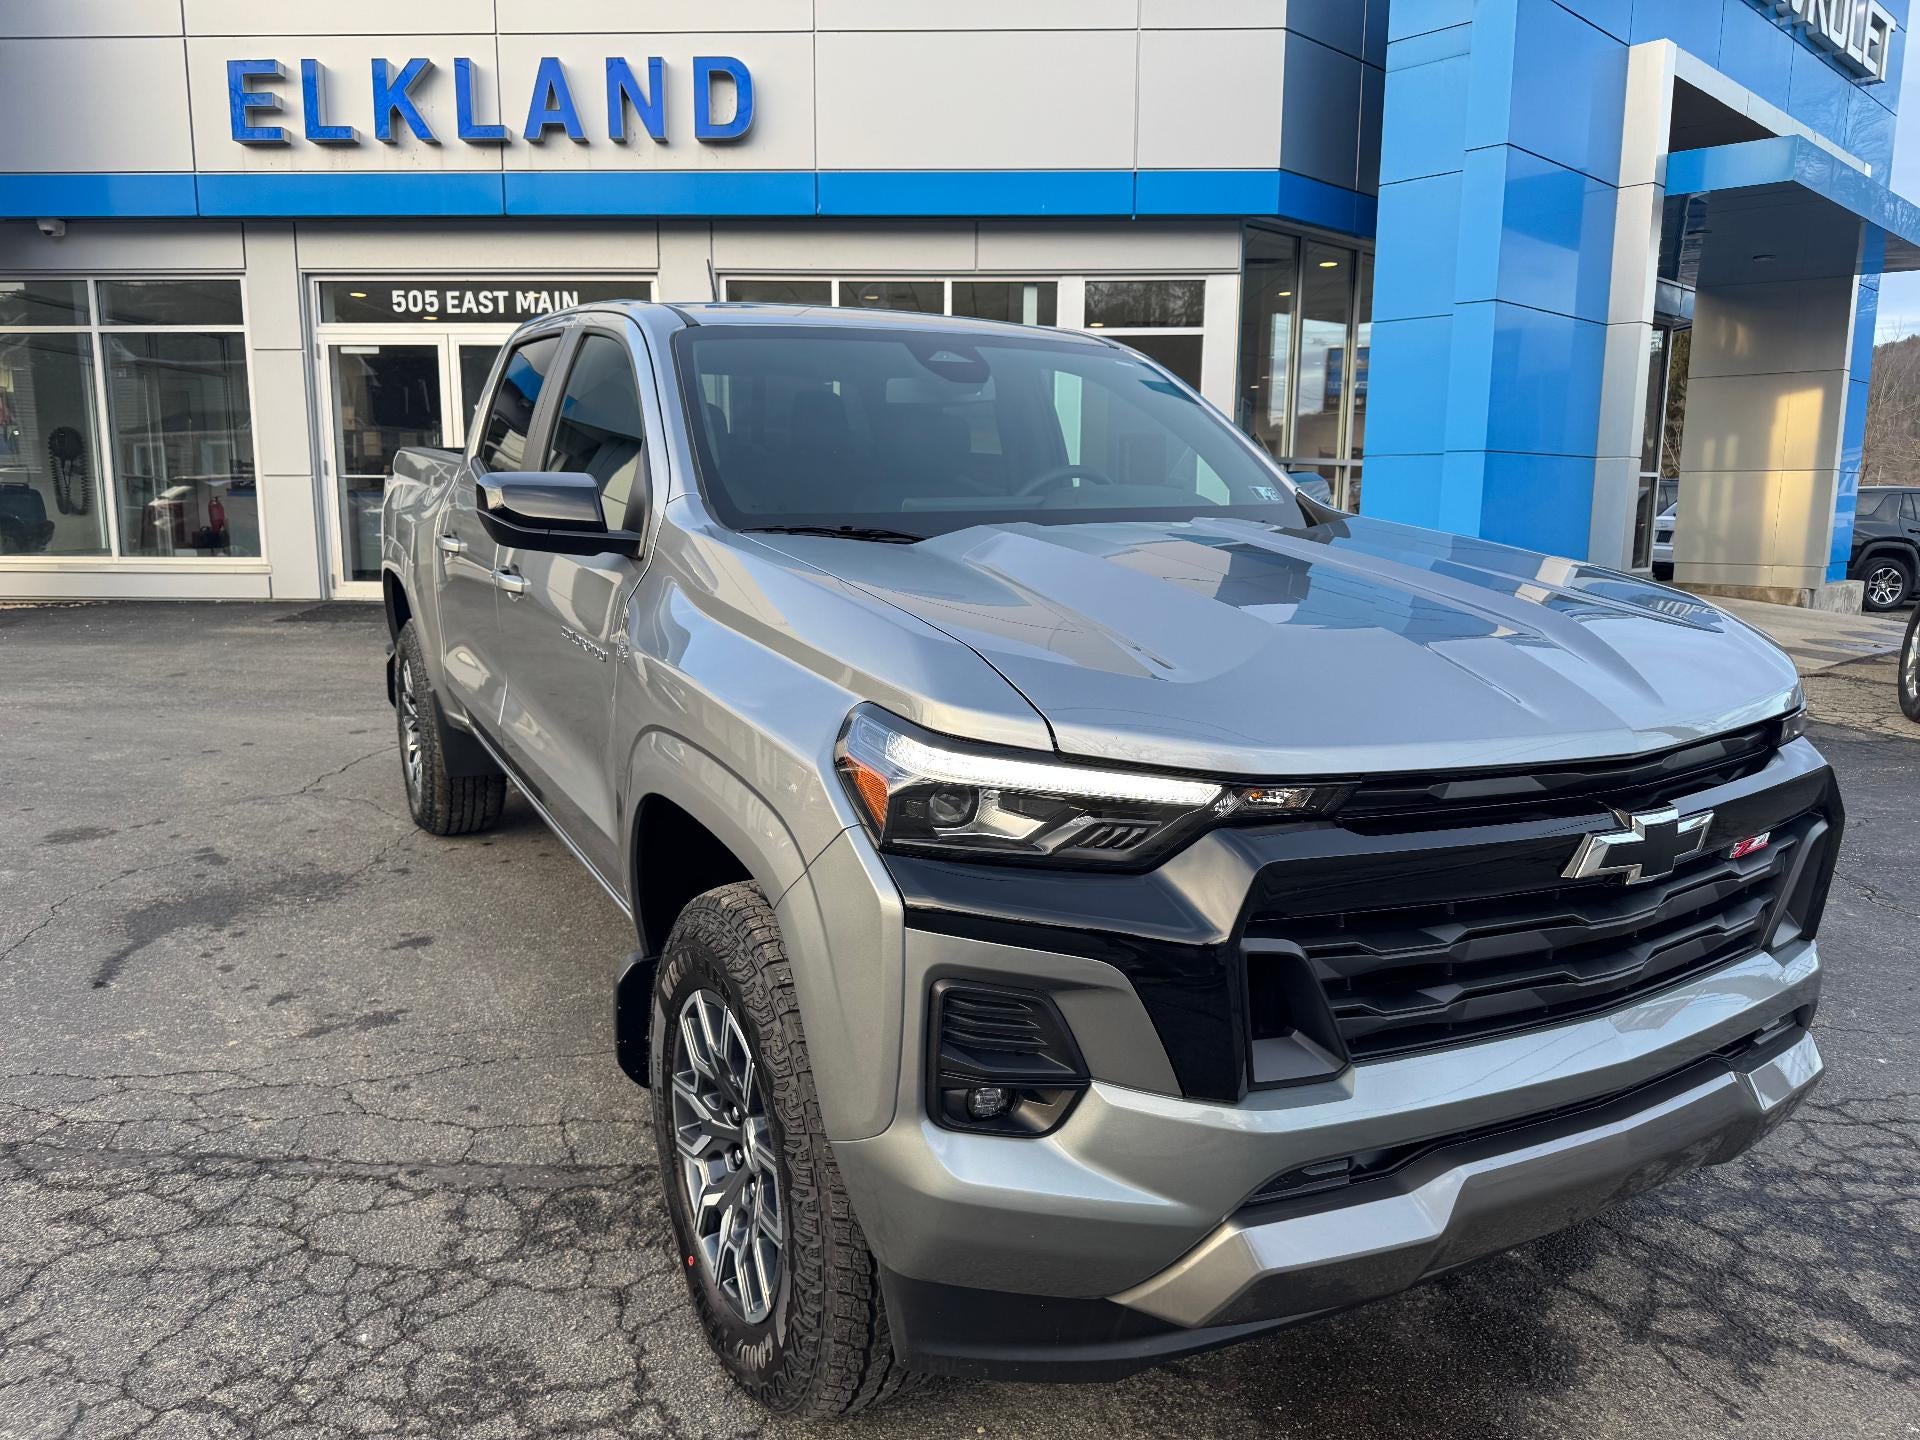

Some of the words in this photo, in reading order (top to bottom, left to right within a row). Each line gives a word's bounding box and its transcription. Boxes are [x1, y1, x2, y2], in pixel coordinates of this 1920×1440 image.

[226, 56, 757, 145] ELKLAND
[391, 290, 439, 312] 505
[446, 291, 509, 314] EAST
[515, 291, 579, 314] MAIN
